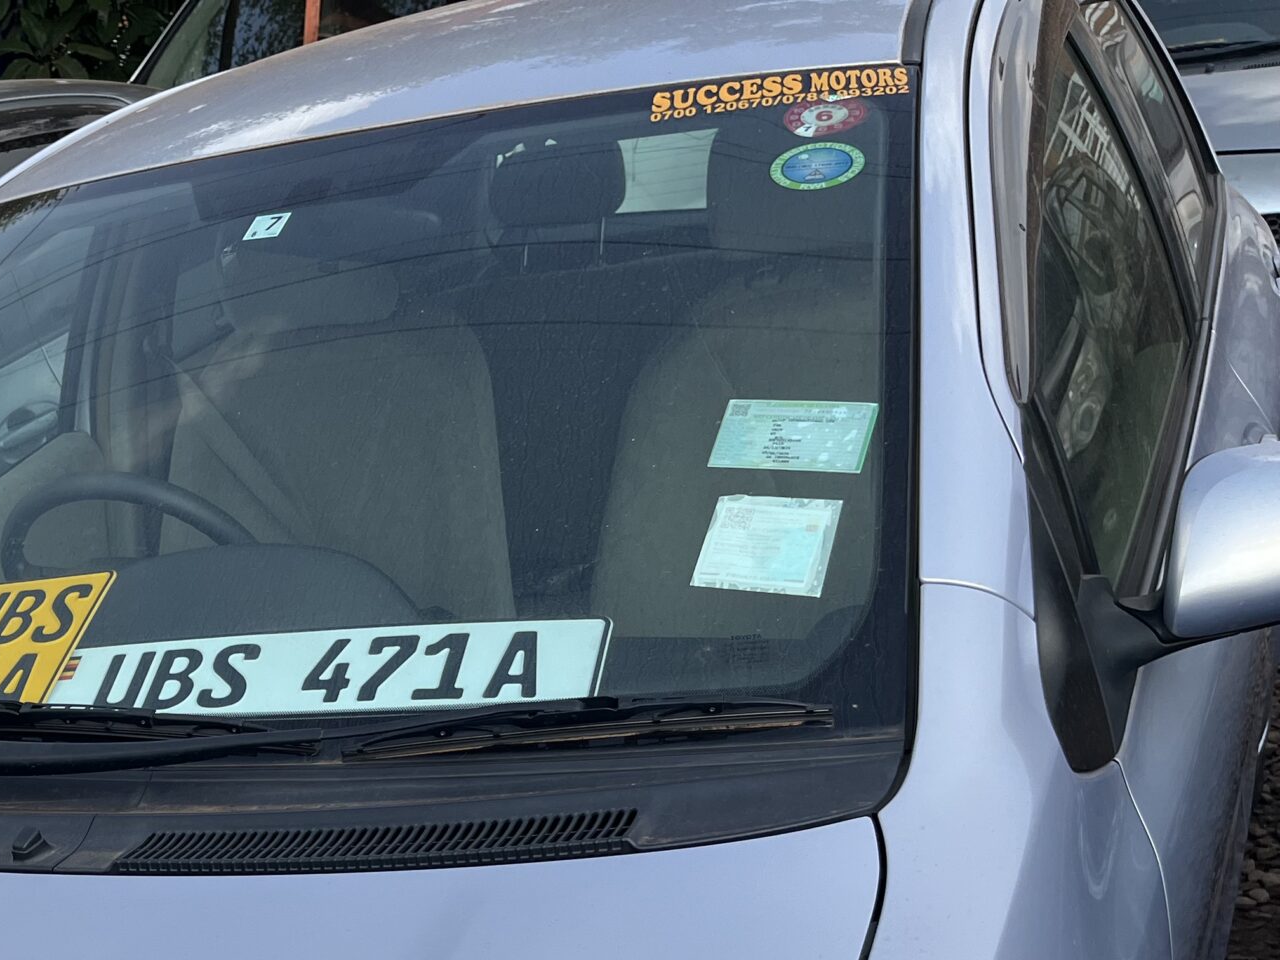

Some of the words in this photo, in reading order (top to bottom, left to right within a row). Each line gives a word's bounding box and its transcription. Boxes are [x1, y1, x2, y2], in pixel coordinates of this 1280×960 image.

[651, 73, 802, 113] SUCCESS
[810, 67, 908, 93] MOTORS
[650, 107, 696, 122] 0700
[94, 644, 261, 709] UBS
[301, 631, 538, 703] 471A
